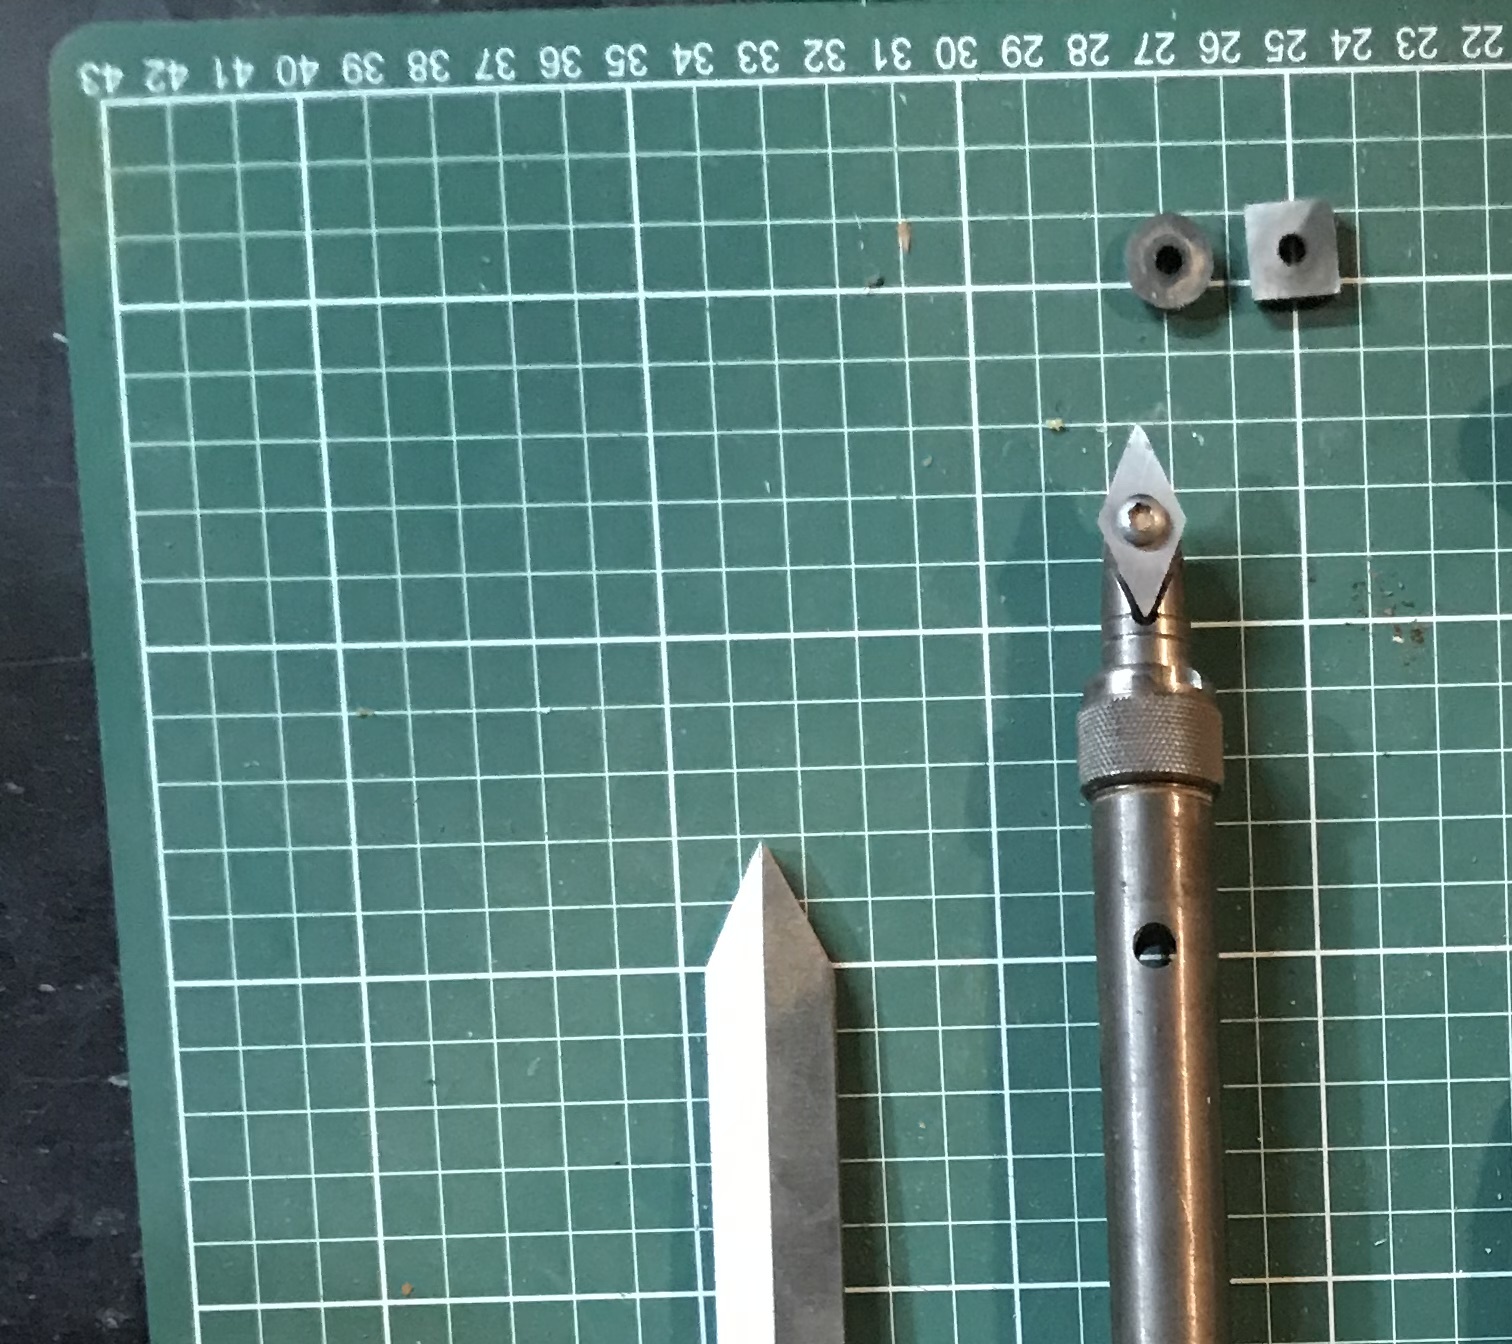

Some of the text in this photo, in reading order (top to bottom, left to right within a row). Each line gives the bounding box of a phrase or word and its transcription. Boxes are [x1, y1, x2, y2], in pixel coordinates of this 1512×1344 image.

[671, 39, 716, 77] 34
[737, 39, 780, 75] 33
[803, 38, 846, 73] 32
[874, 36, 912, 72] 31
[935, 35, 978, 70] 30
[1001, 34, 1044, 69] 29
[1066, 31, 1110, 67] 28
[1133, 31, 1175, 66] 27
[1198, 29, 1242, 65] 26
[1264, 28, 1307, 63] 25
[1330, 27, 1372, 62] 24
[1395, 26, 1438, 61] 23
[1461, 24, 1504, 59] 22
[76, 59, 125, 97] 43
[140, 55, 191, 94] 42
[209, 53, 256, 91] 41
[276, 54, 320, 88] 40
[341, 51, 385, 86] 39
[407, 48, 450, 84] 38
[474, 47, 516, 82] 37
[539, 45, 583, 80] 36
[604, 43, 648, 78] 35
